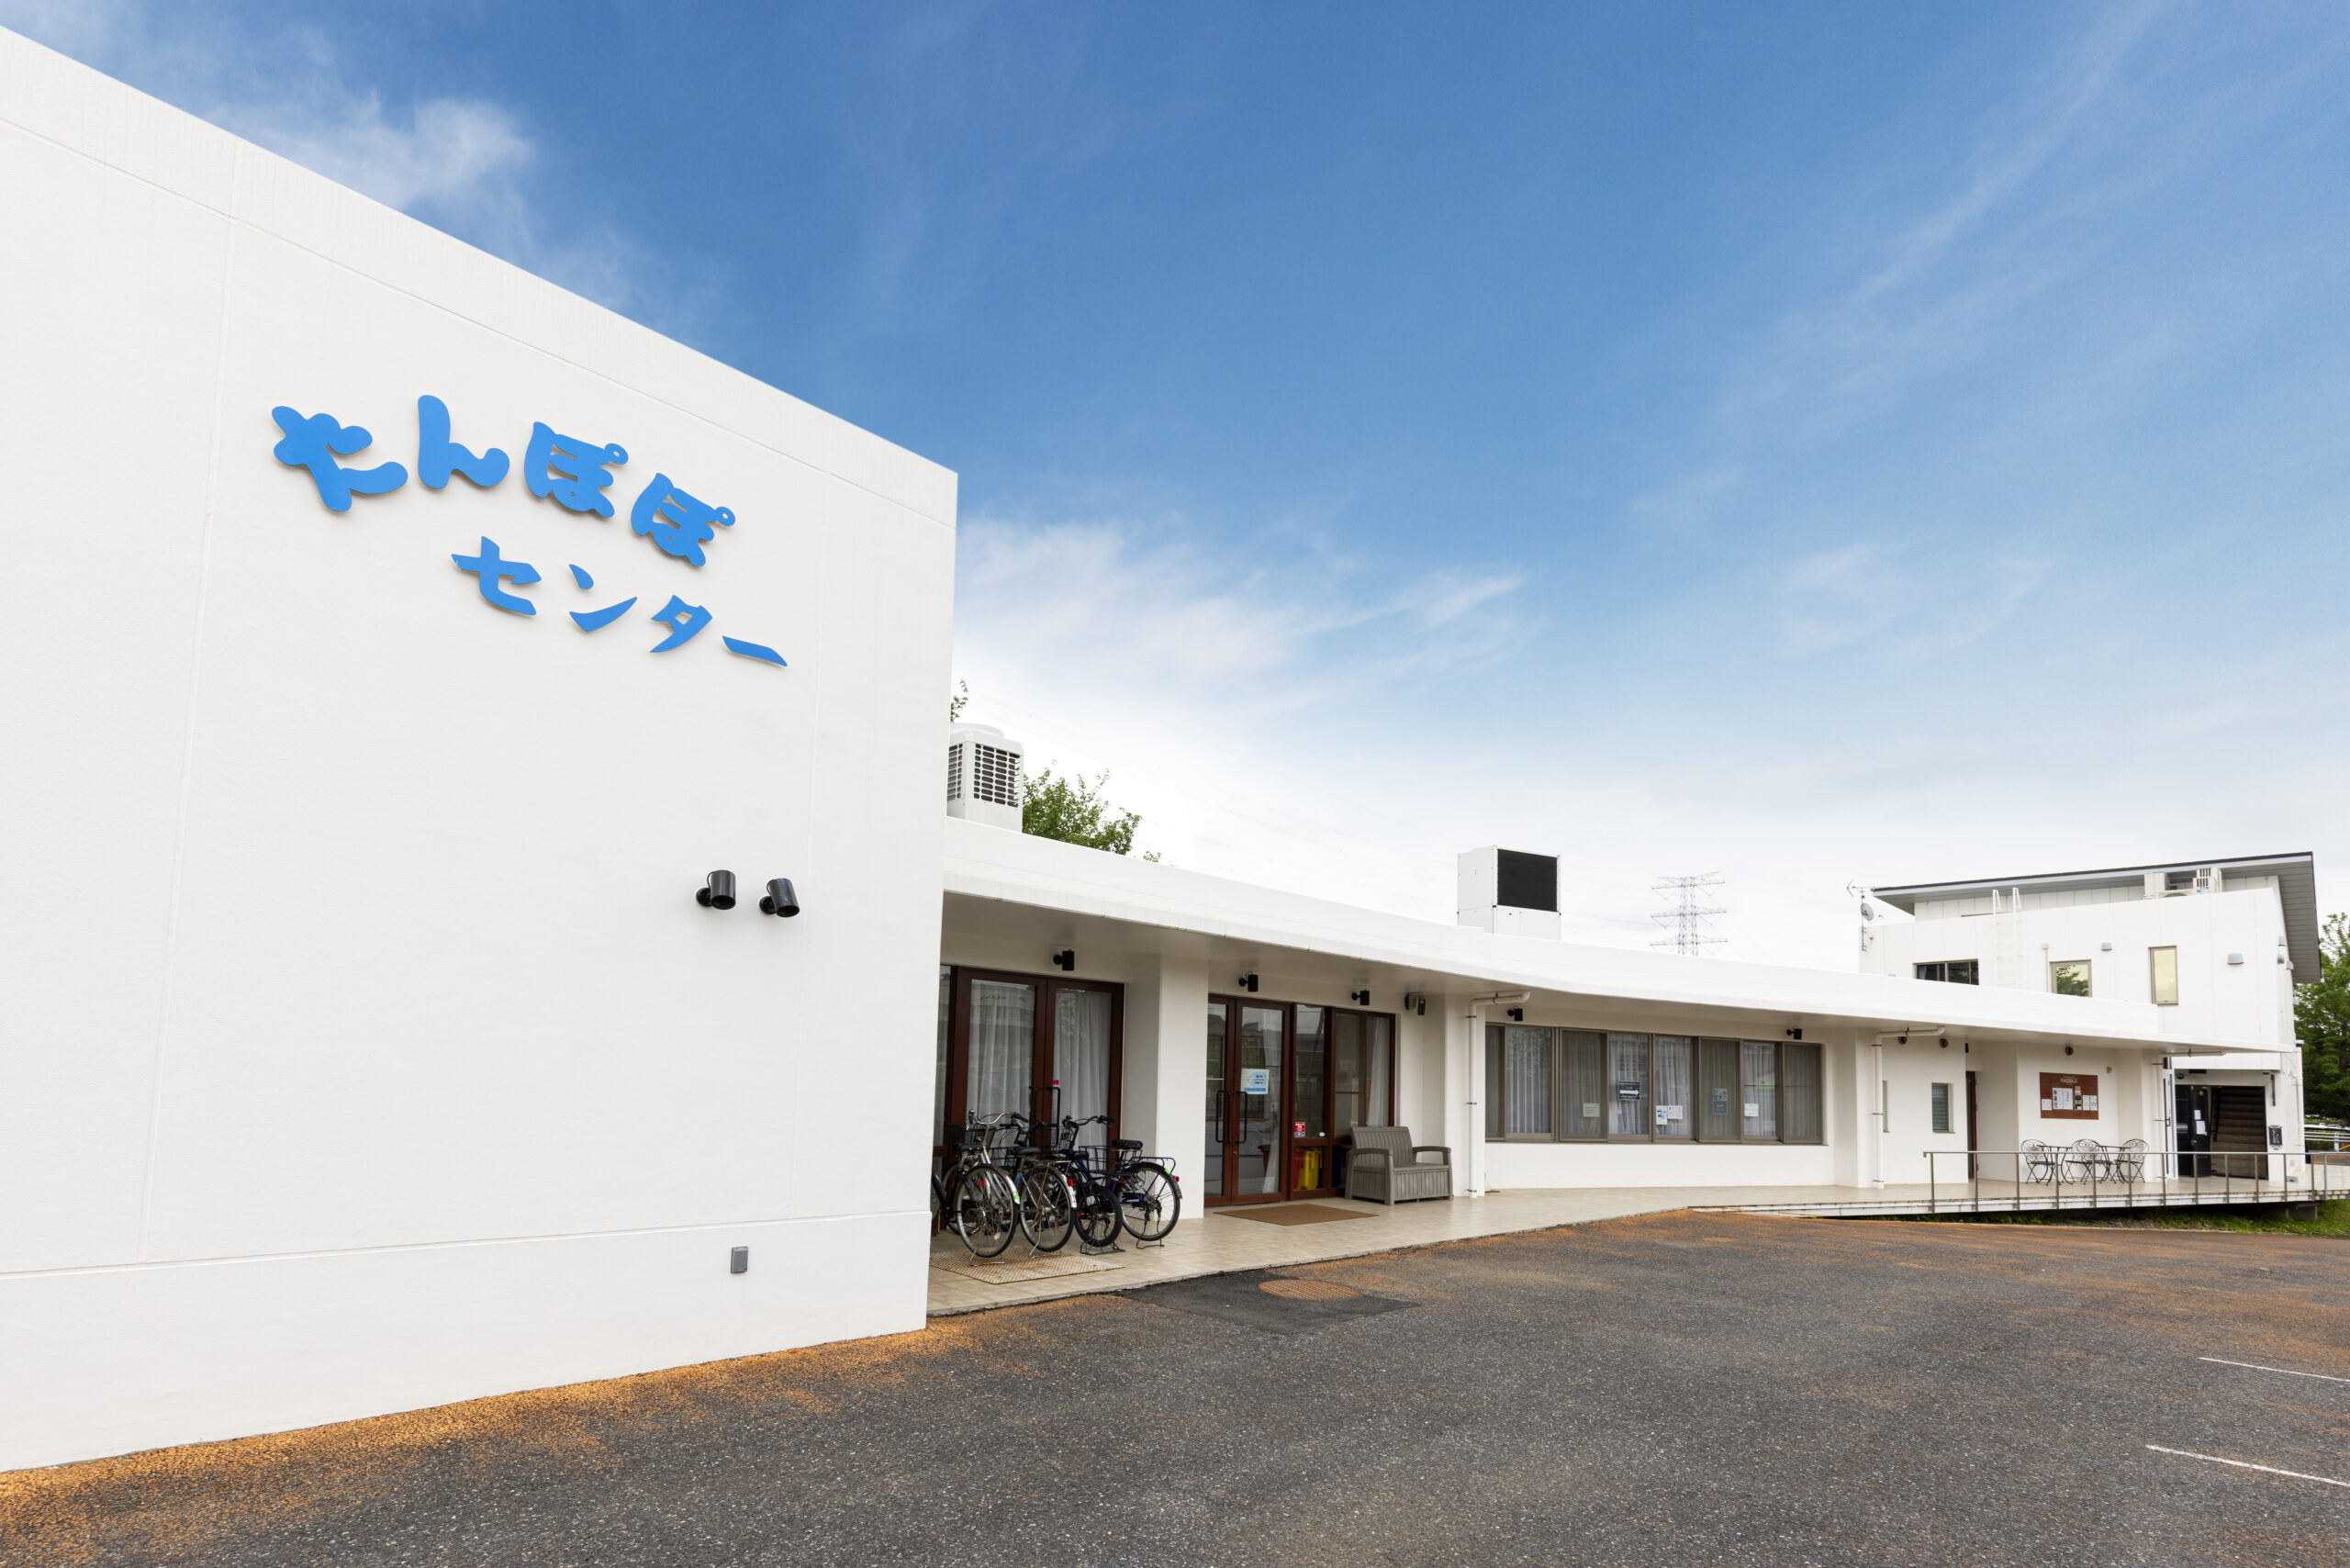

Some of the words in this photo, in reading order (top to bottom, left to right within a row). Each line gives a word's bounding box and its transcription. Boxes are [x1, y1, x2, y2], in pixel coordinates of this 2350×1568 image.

[271, 395, 735, 567] たんぽぽ
[451, 536, 788, 666] センター
